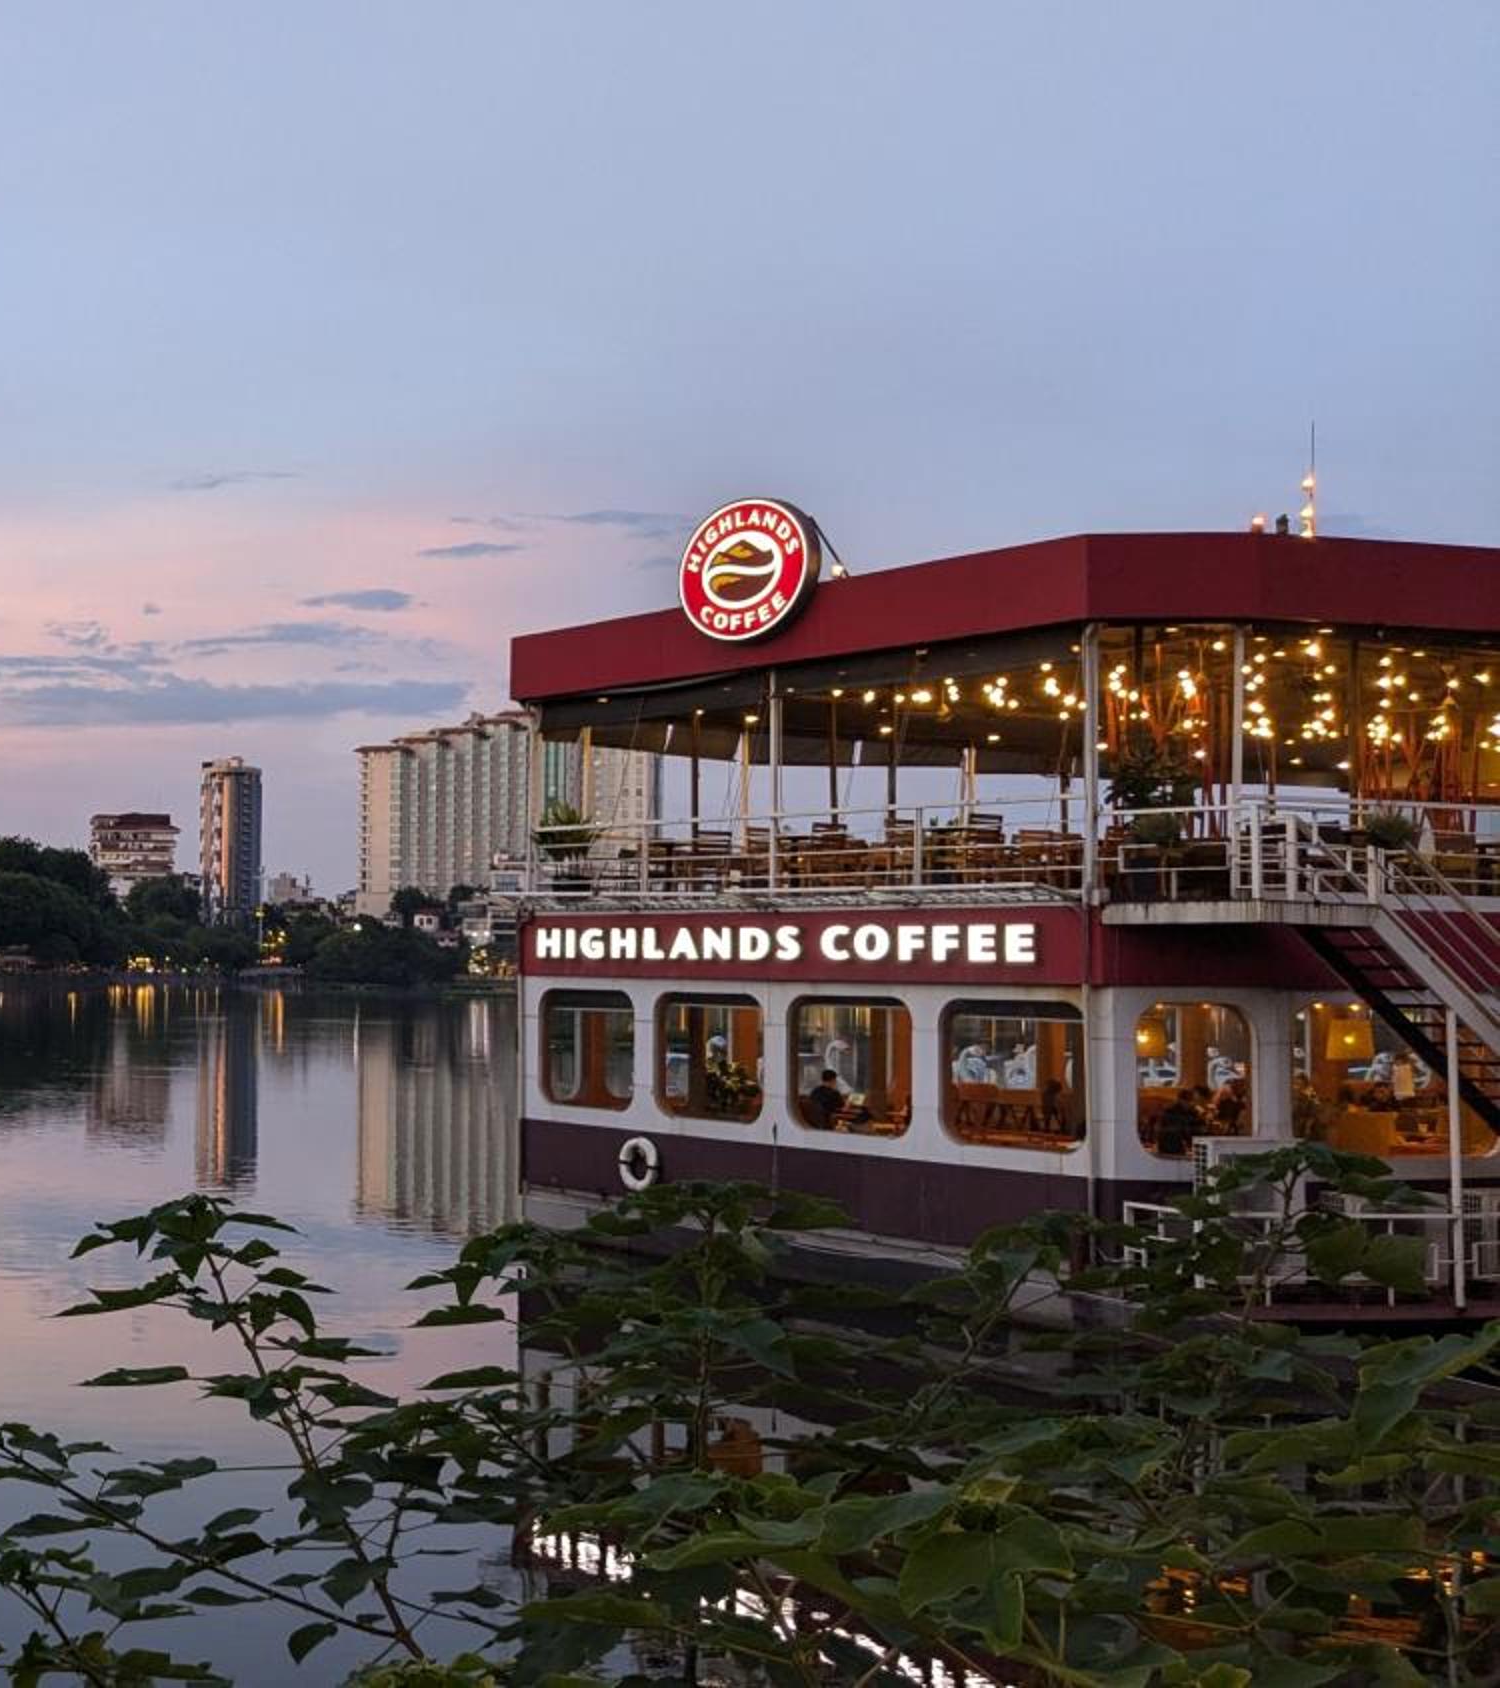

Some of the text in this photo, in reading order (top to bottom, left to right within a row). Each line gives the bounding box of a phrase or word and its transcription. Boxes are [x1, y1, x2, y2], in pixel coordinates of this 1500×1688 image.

[687, 509, 799, 573] HIGHLANDS
[700, 591, 786, 631] COFFEE
[535, 923, 1036, 963] HIGHLANDS COFFEE
